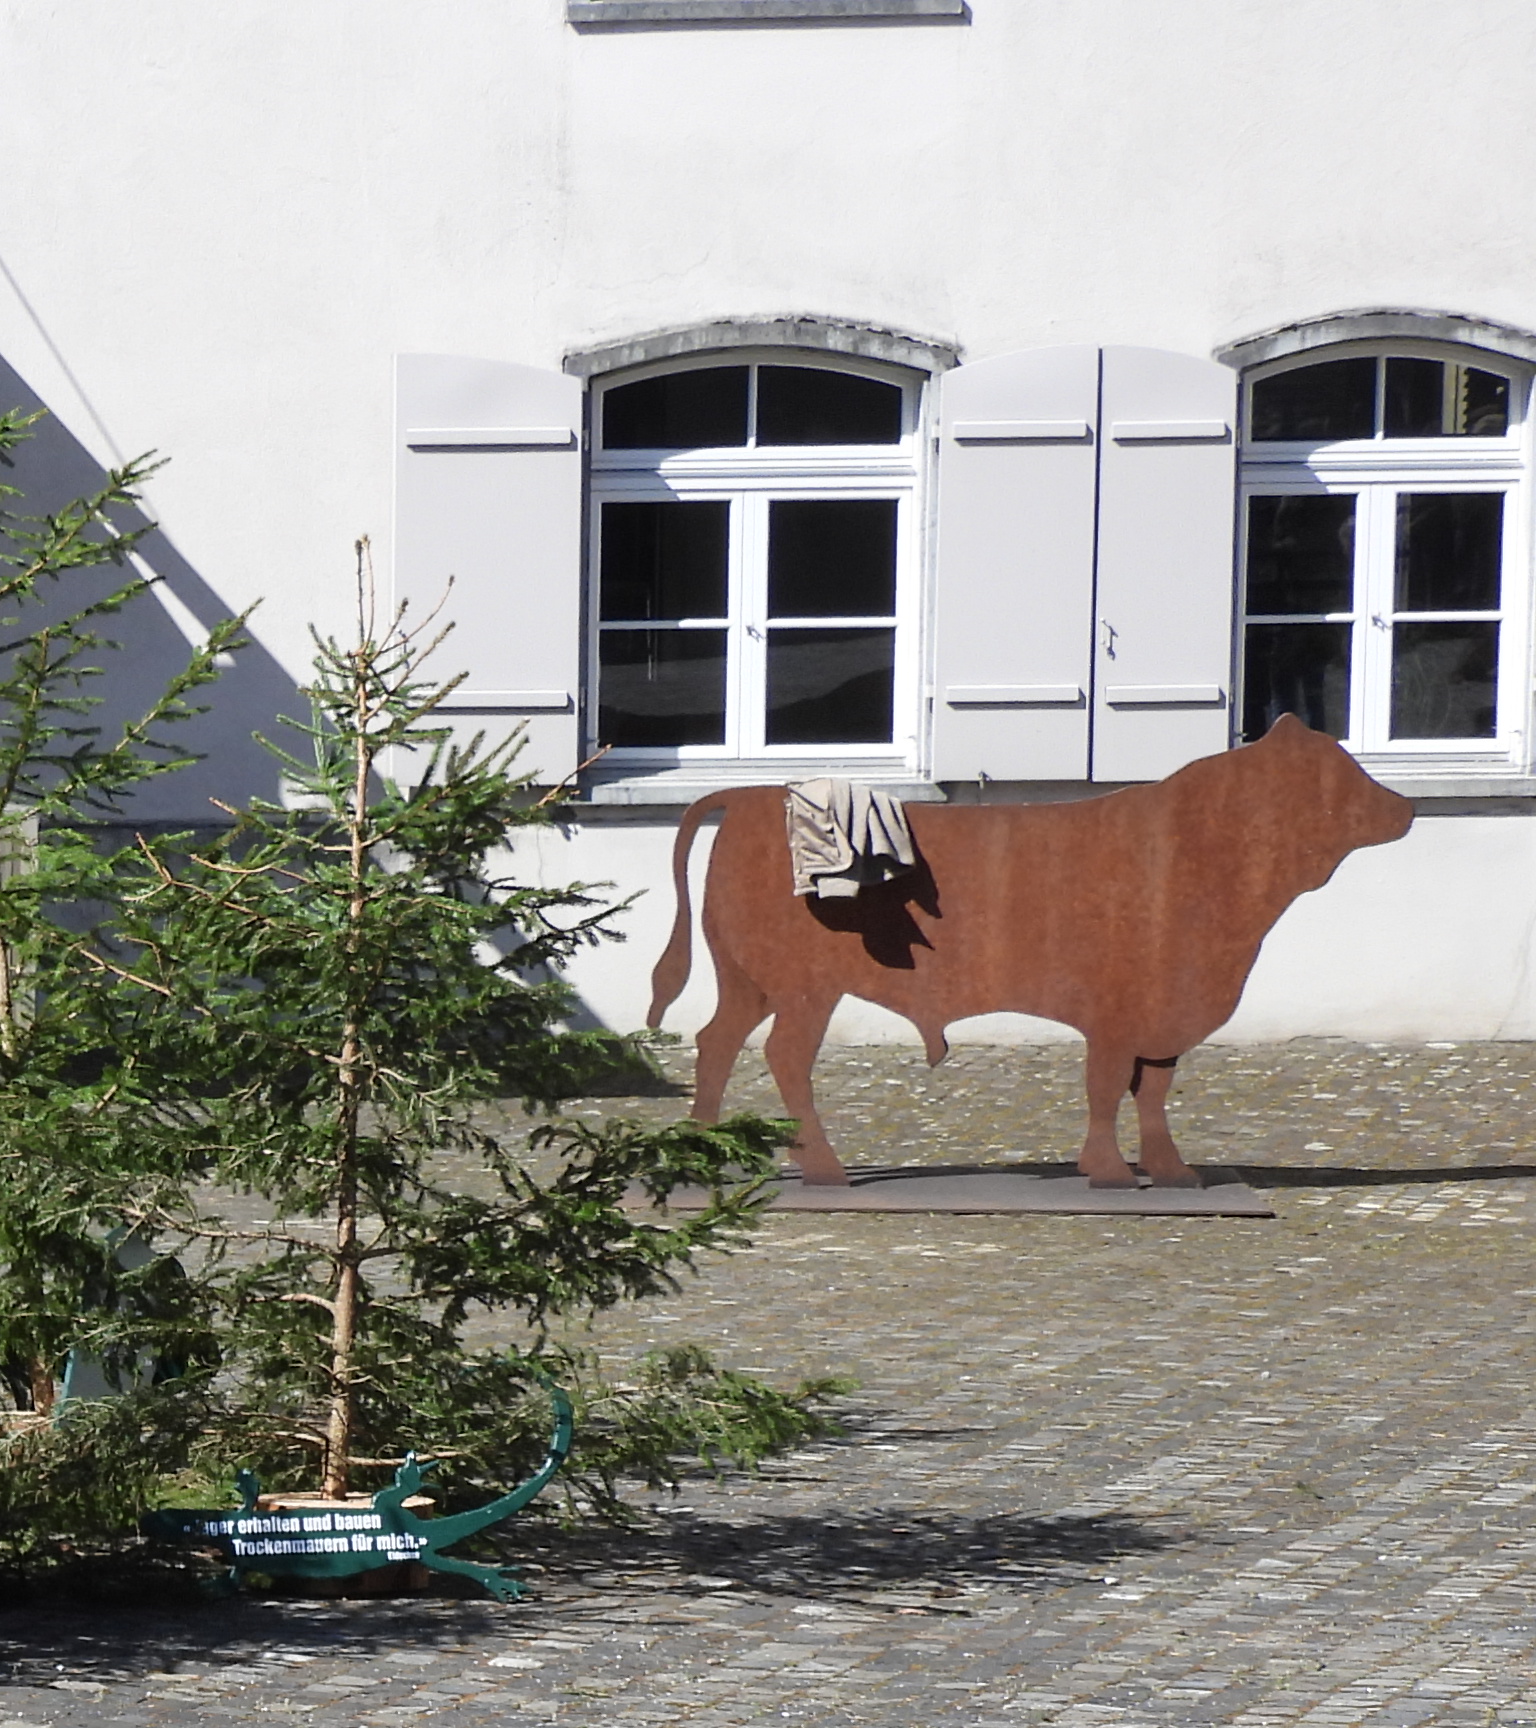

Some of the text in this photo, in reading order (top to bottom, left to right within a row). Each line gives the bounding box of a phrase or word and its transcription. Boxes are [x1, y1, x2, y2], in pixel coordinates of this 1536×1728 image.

[237, 1515, 301, 1535] erhalten
[302, 1513, 333, 1532] und
[334, 1513, 382, 1531] bauen
[231, 1536, 350, 1556] Trockenmauern
[351, 1533, 373, 1552] für
